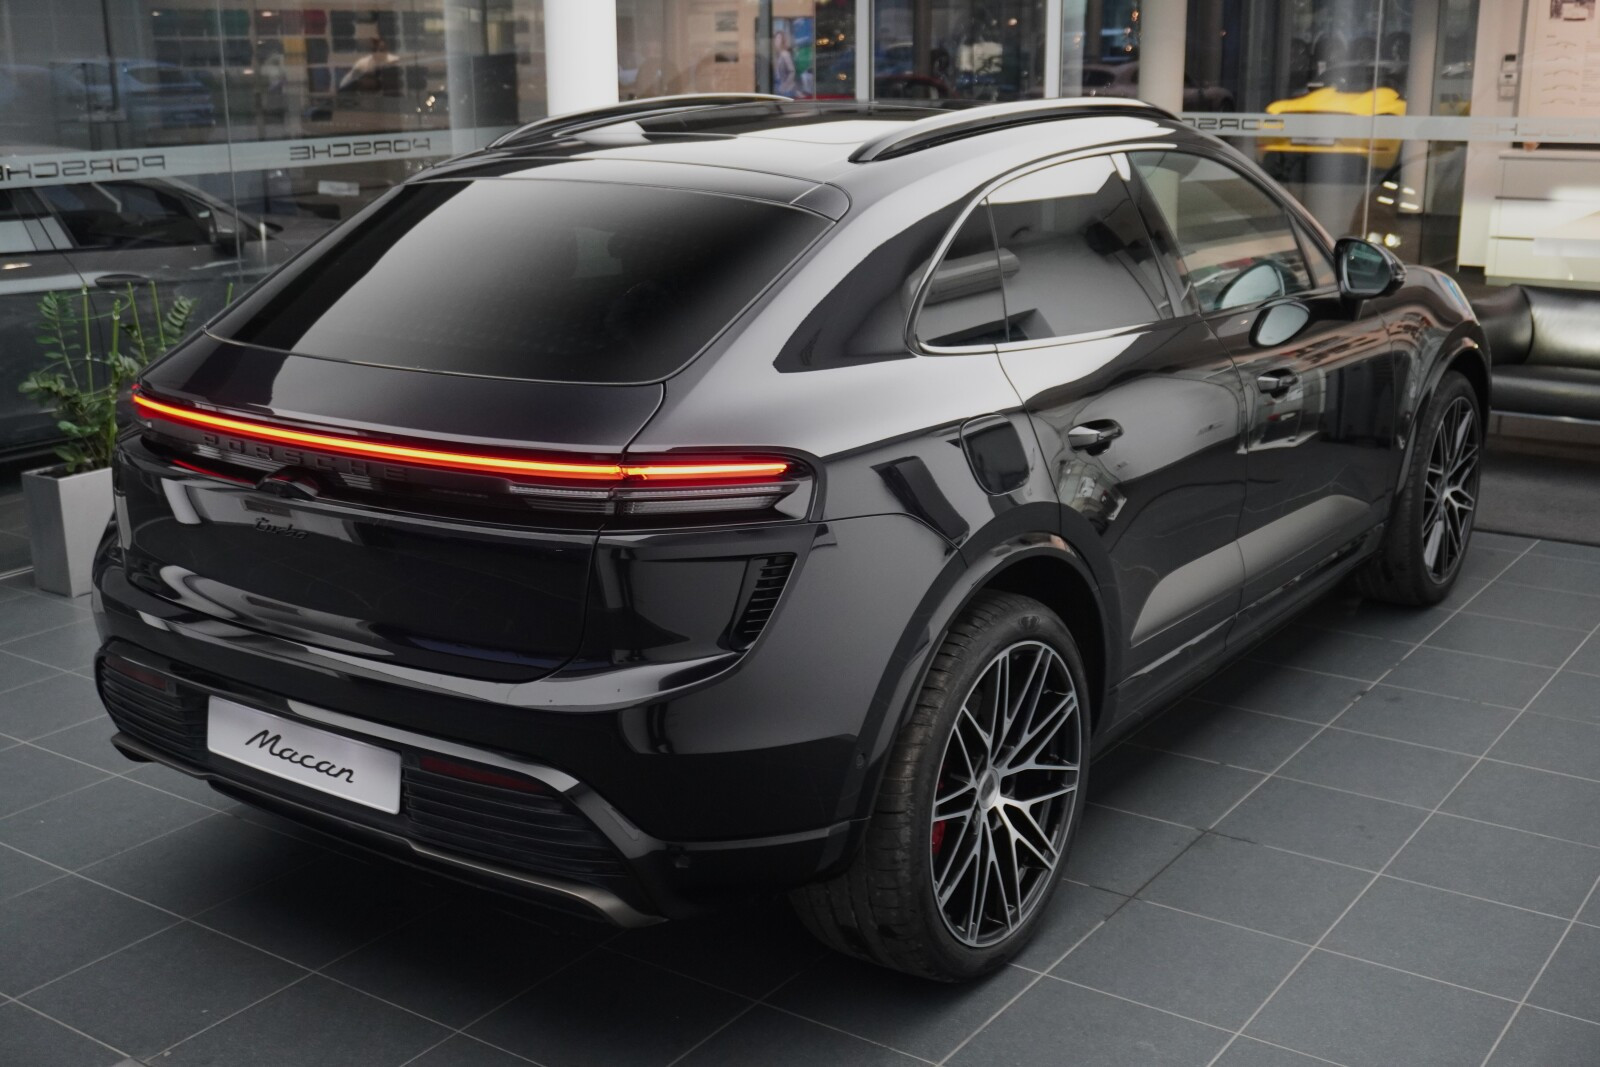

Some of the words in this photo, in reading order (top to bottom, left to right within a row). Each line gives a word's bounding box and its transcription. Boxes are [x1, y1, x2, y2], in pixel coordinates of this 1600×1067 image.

[201, 432, 408, 481] PORSCHE
[255, 517, 308, 539] turbo
[244, 729, 354, 783] Macan
